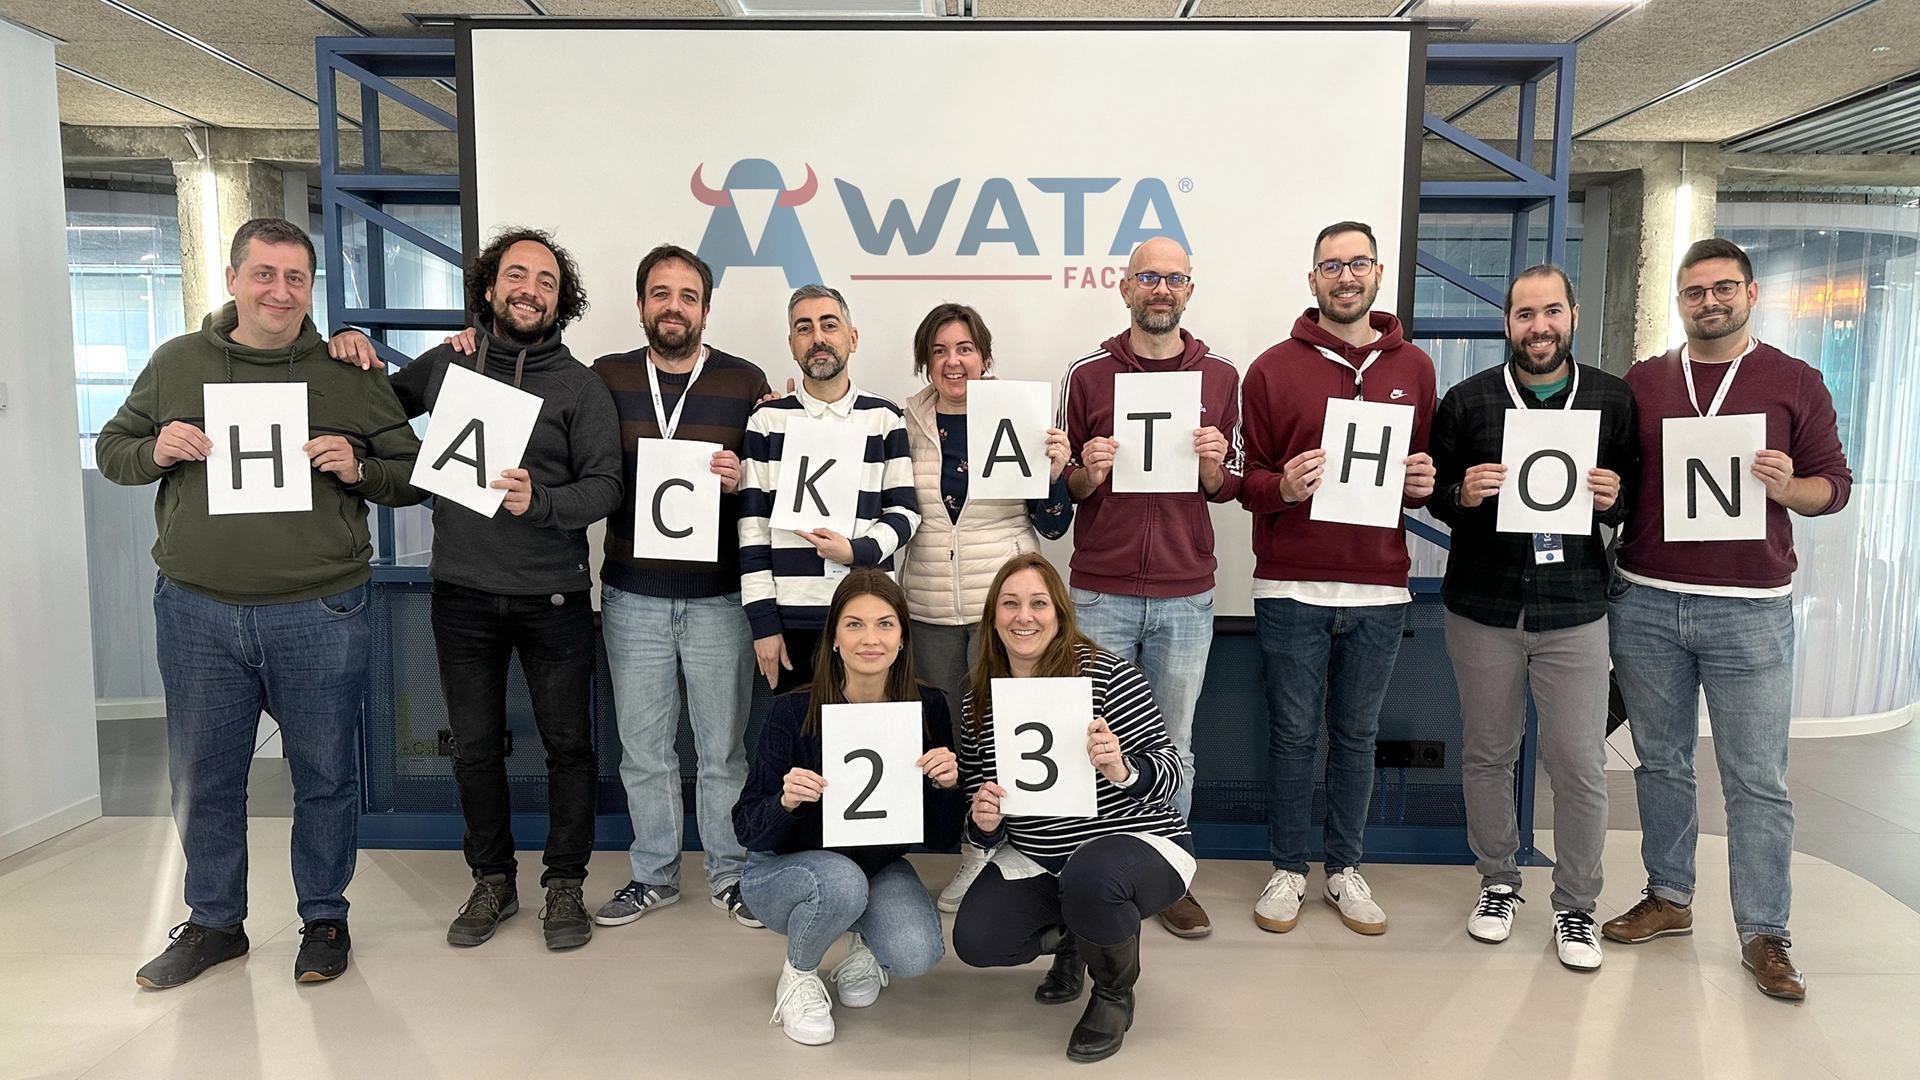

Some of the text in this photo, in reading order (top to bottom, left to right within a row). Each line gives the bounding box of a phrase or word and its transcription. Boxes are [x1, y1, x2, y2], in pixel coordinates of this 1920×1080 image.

[229, 423, 284, 490] H
[431, 417, 487, 489] A
[981, 418, 1033, 479] A
[1126, 411, 1172, 472] T
[1339, 422, 1392, 487] H
[652, 478, 694, 538] C
[792, 455, 837, 517] K
[1517, 449, 1578, 512] O
[1686, 456, 1741, 520] N
[843, 748, 888, 821] 2
[1014, 721, 1059, 793] 3
